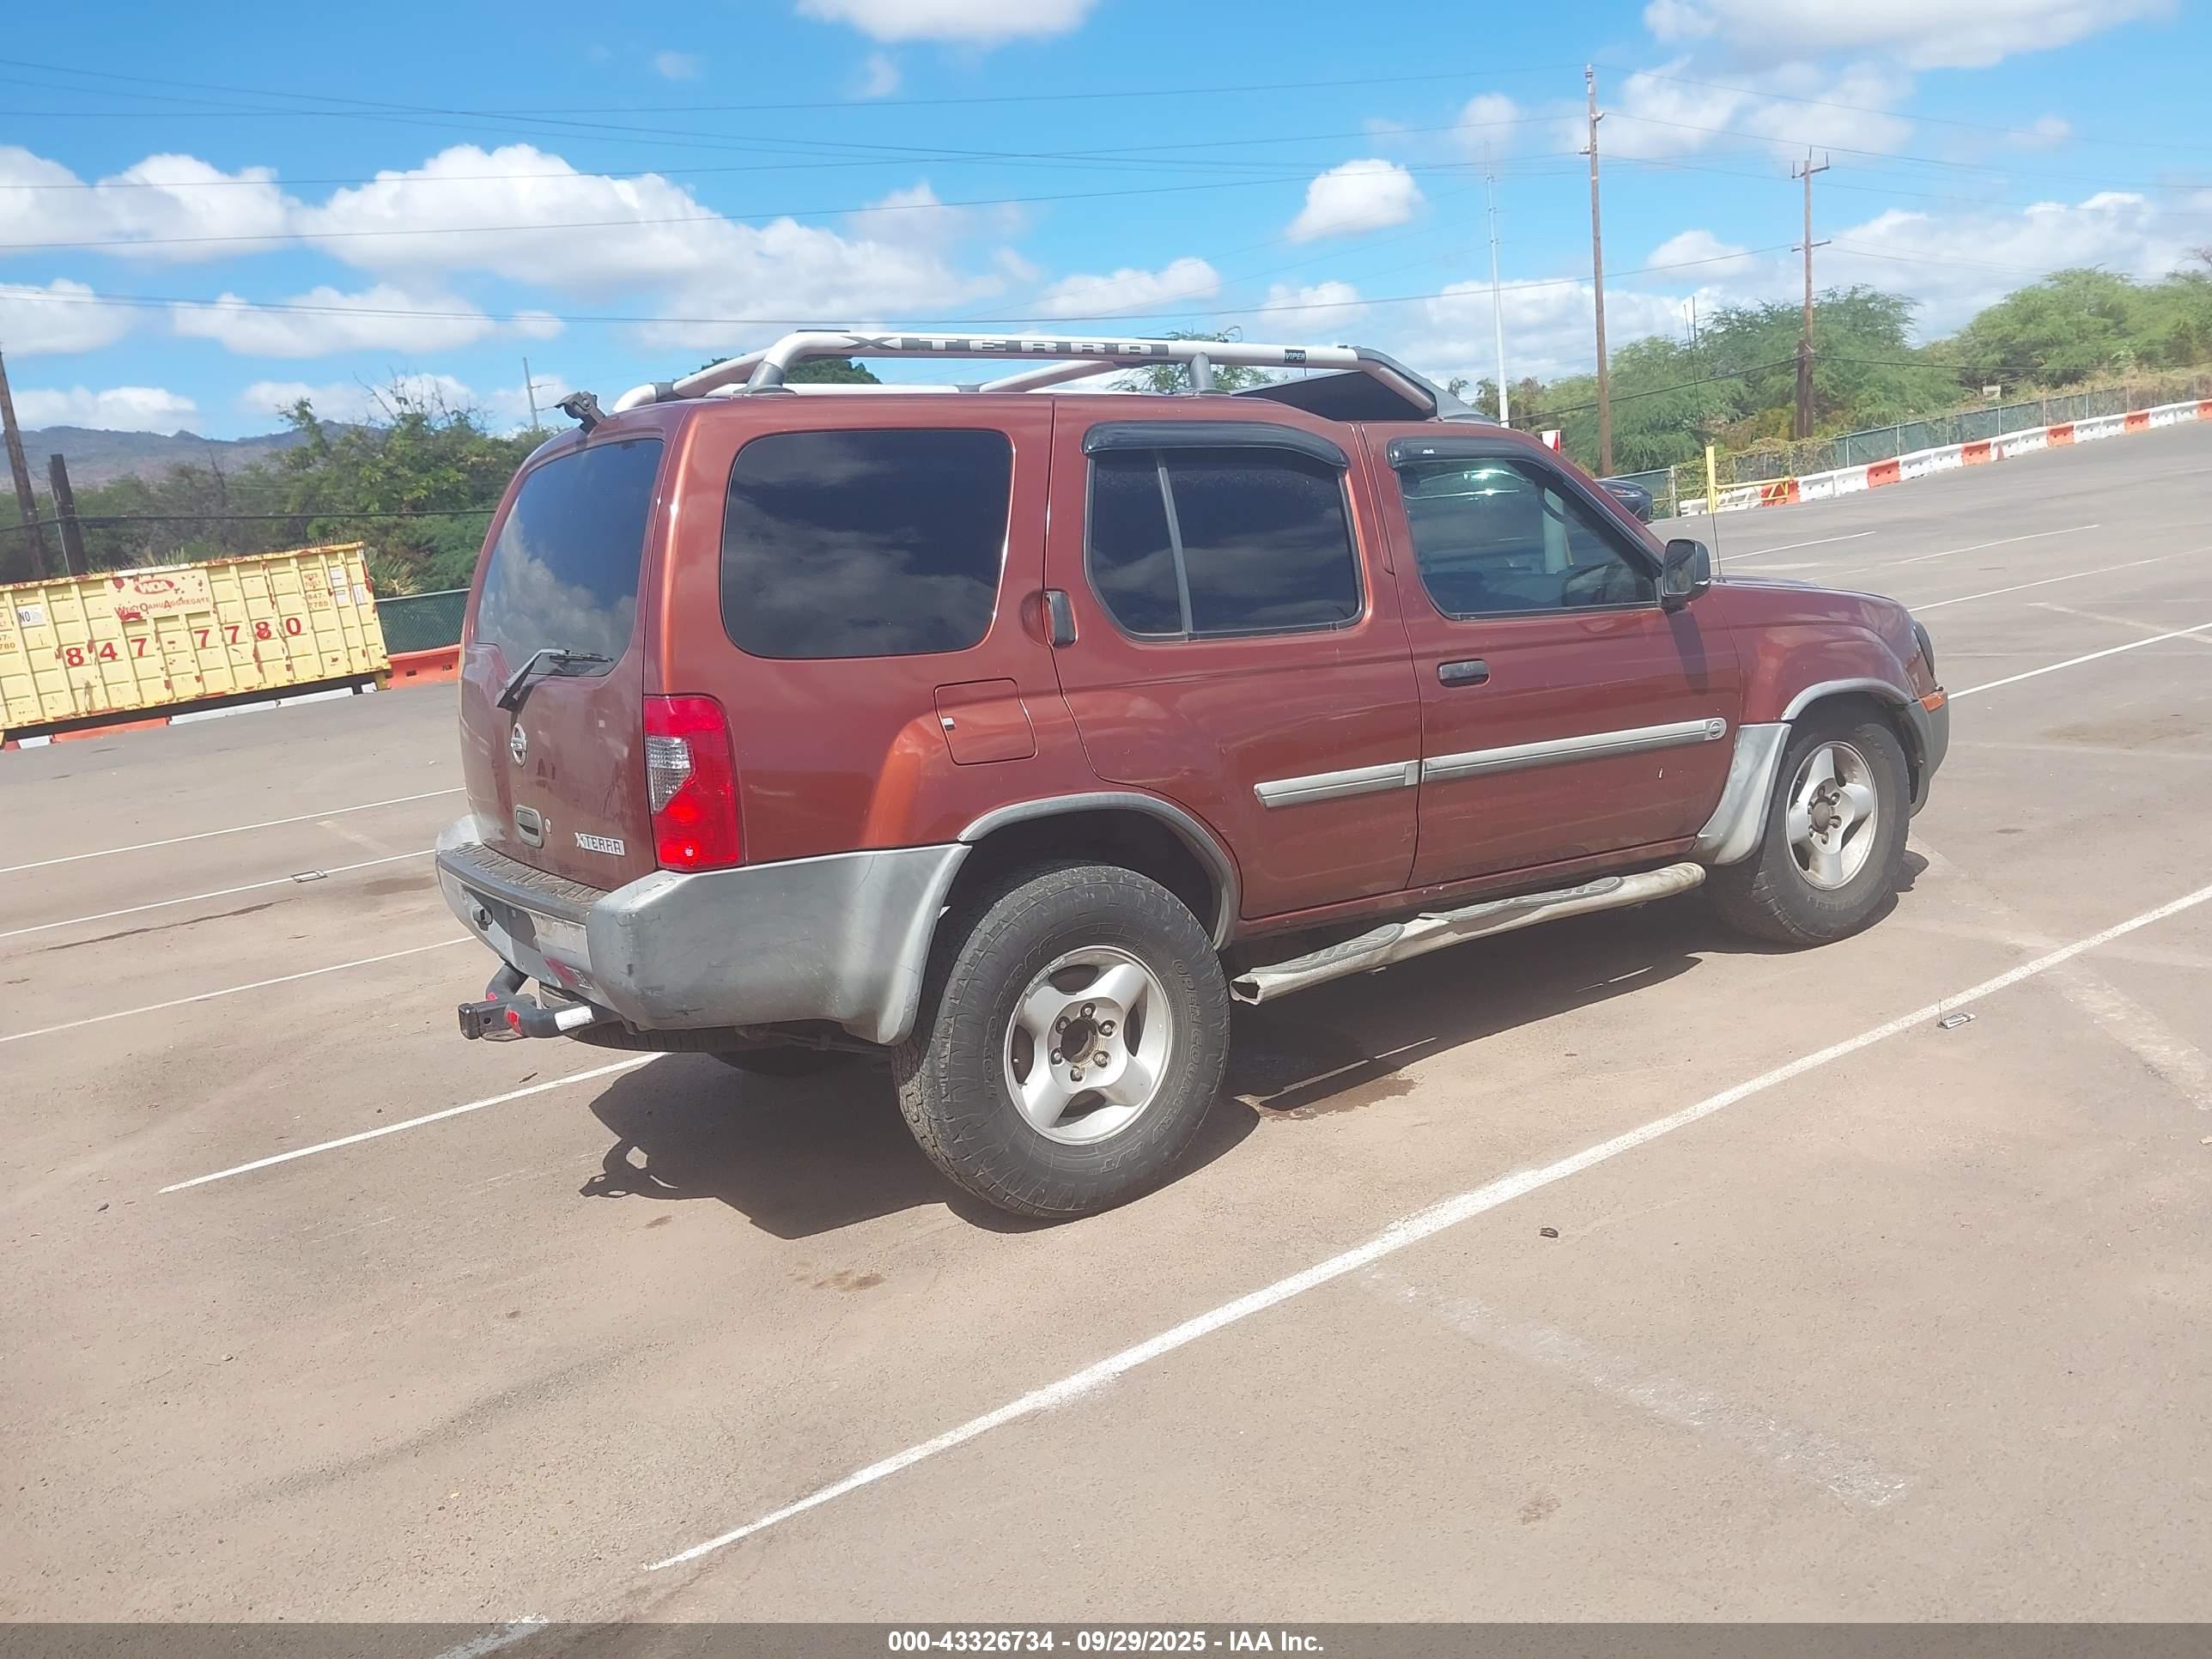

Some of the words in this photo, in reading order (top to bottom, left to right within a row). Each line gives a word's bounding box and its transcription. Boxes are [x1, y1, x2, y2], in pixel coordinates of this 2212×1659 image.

[841, 335, 1155, 356] XTERRA
[1285, 351, 1306, 362] VIPER
[18, 611, 32, 623] NO
[65, 617, 301, 667] 847-7780
[574, 831, 625, 855] XTERRA
